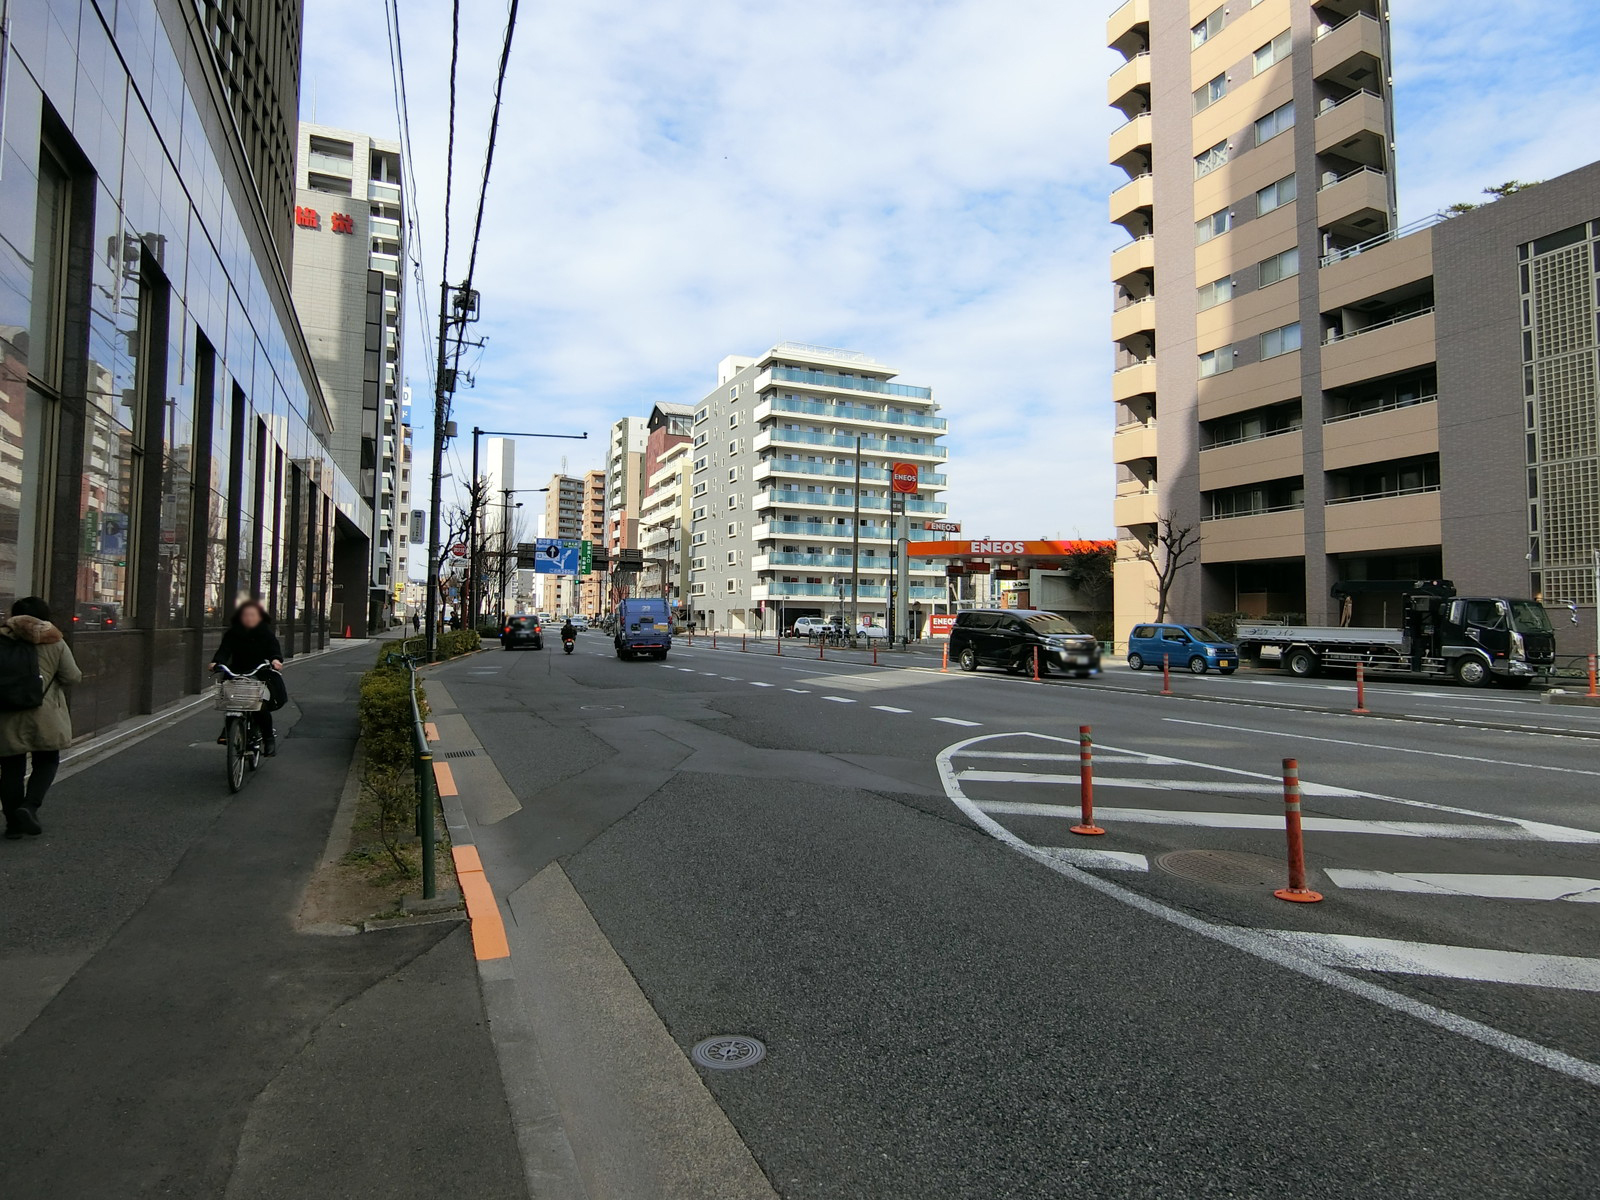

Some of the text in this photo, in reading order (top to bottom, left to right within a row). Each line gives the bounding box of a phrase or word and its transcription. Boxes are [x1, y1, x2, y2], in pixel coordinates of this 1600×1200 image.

[894, 474, 916, 482] ENEOS
[931, 522, 957, 532] ENEOS
[971, 542, 1024, 553] ENEOS
